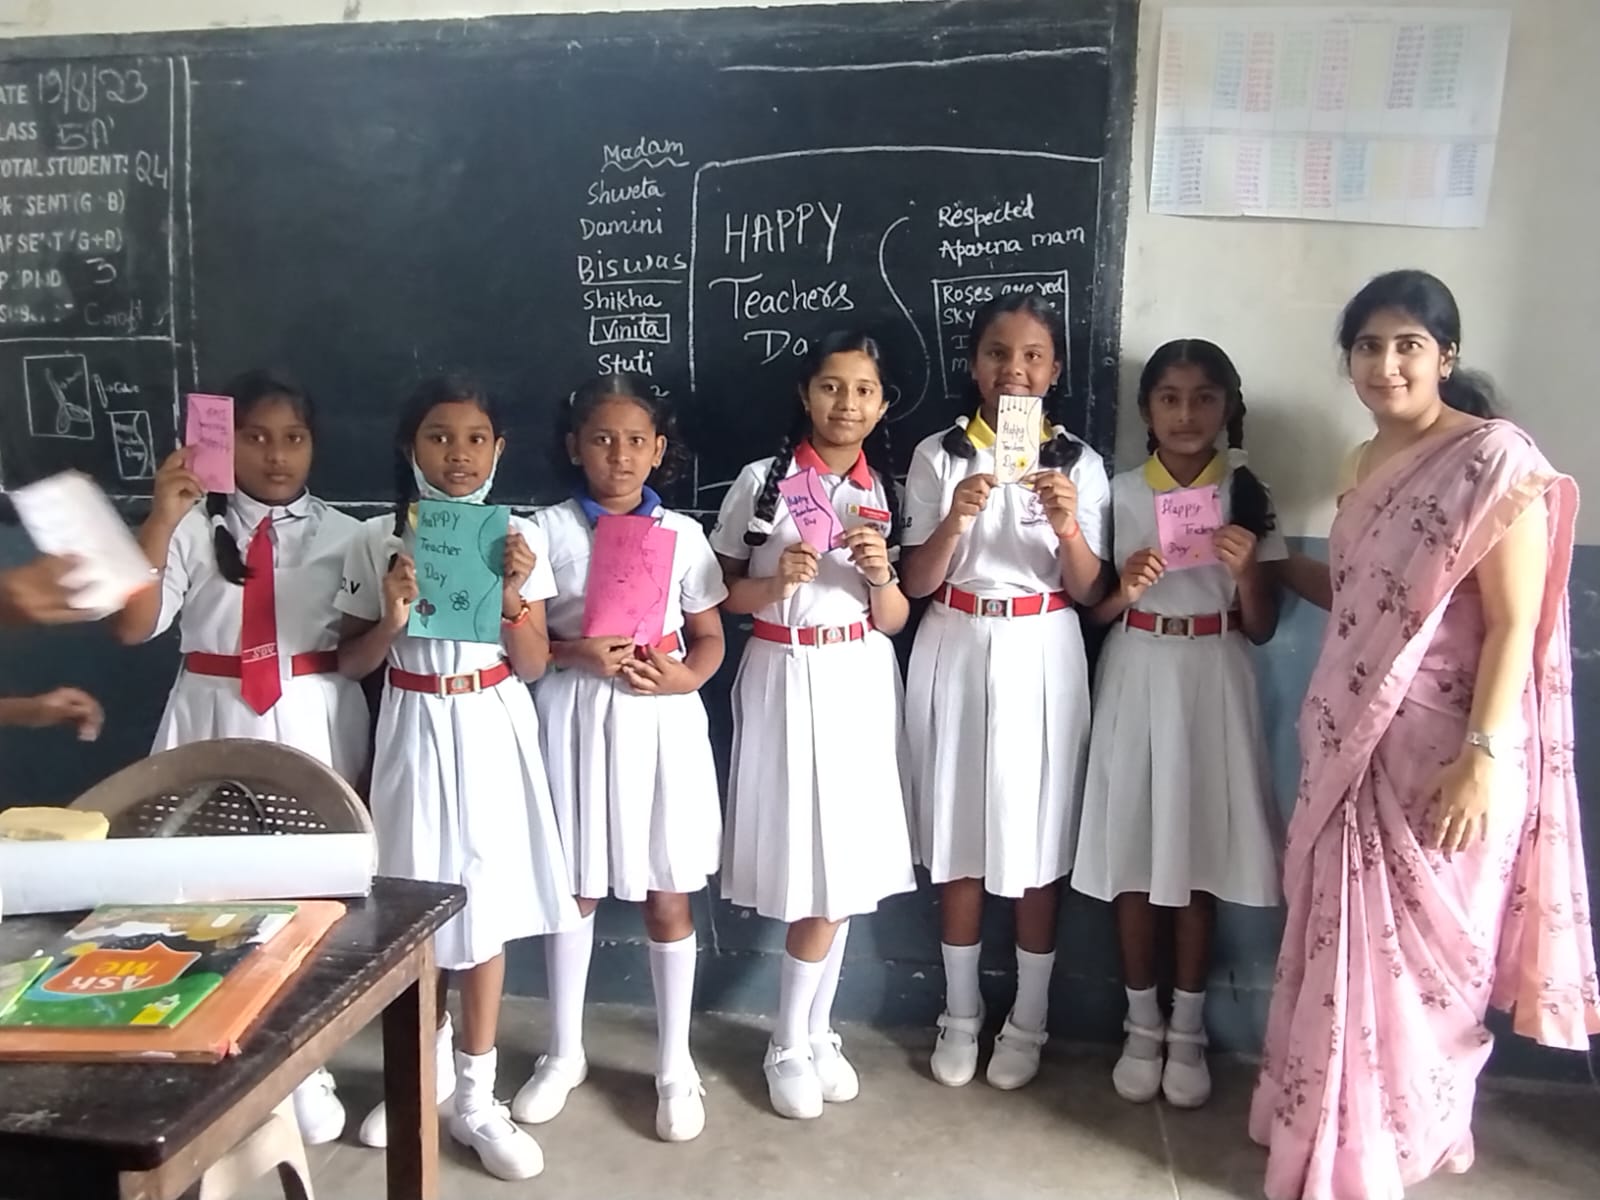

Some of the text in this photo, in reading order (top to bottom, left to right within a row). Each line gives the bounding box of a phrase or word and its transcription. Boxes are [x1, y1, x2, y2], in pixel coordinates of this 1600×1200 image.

[603, 136, 684, 162] Madam
[586, 176, 666, 205] Shweta
[580, 207, 663, 240] Damini
[938, 193, 1035, 238] Respected
[725, 201, 842, 264] HAPPY
[1031, 226, 1085, 247] mam
[577, 249, 687, 281] Biswas
[583, 289, 662, 312] Shikha
[708, 273, 855, 319] Teachers
[942, 285, 994, 306] Roses
[602, 313, 664, 340] Vinita
[743, 330, 808, 365] Da
[598, 349, 653, 376] Stuti
